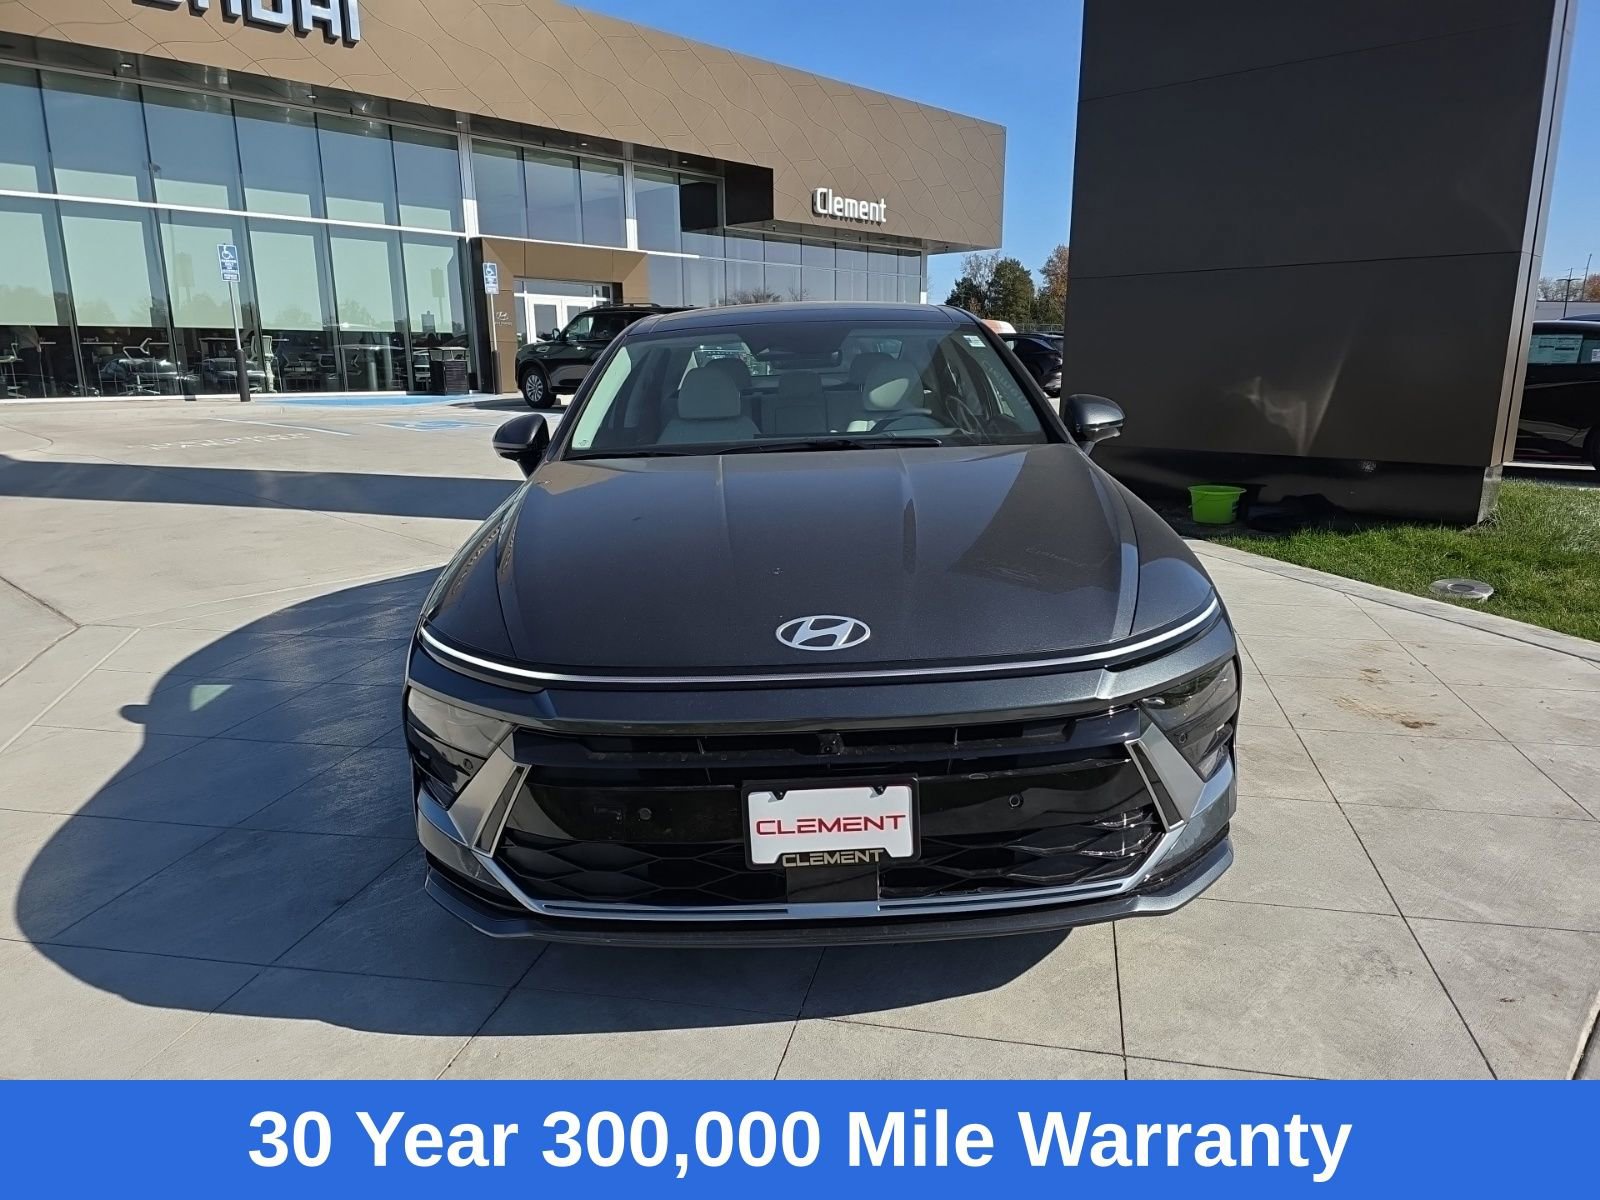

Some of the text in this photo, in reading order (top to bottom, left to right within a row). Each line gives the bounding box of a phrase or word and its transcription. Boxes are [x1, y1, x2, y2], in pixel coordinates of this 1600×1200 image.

[814, 187, 887, 223] Clement
[756, 814, 906, 836] CLEMENT
[782, 849, 884, 867] CLEMENT
